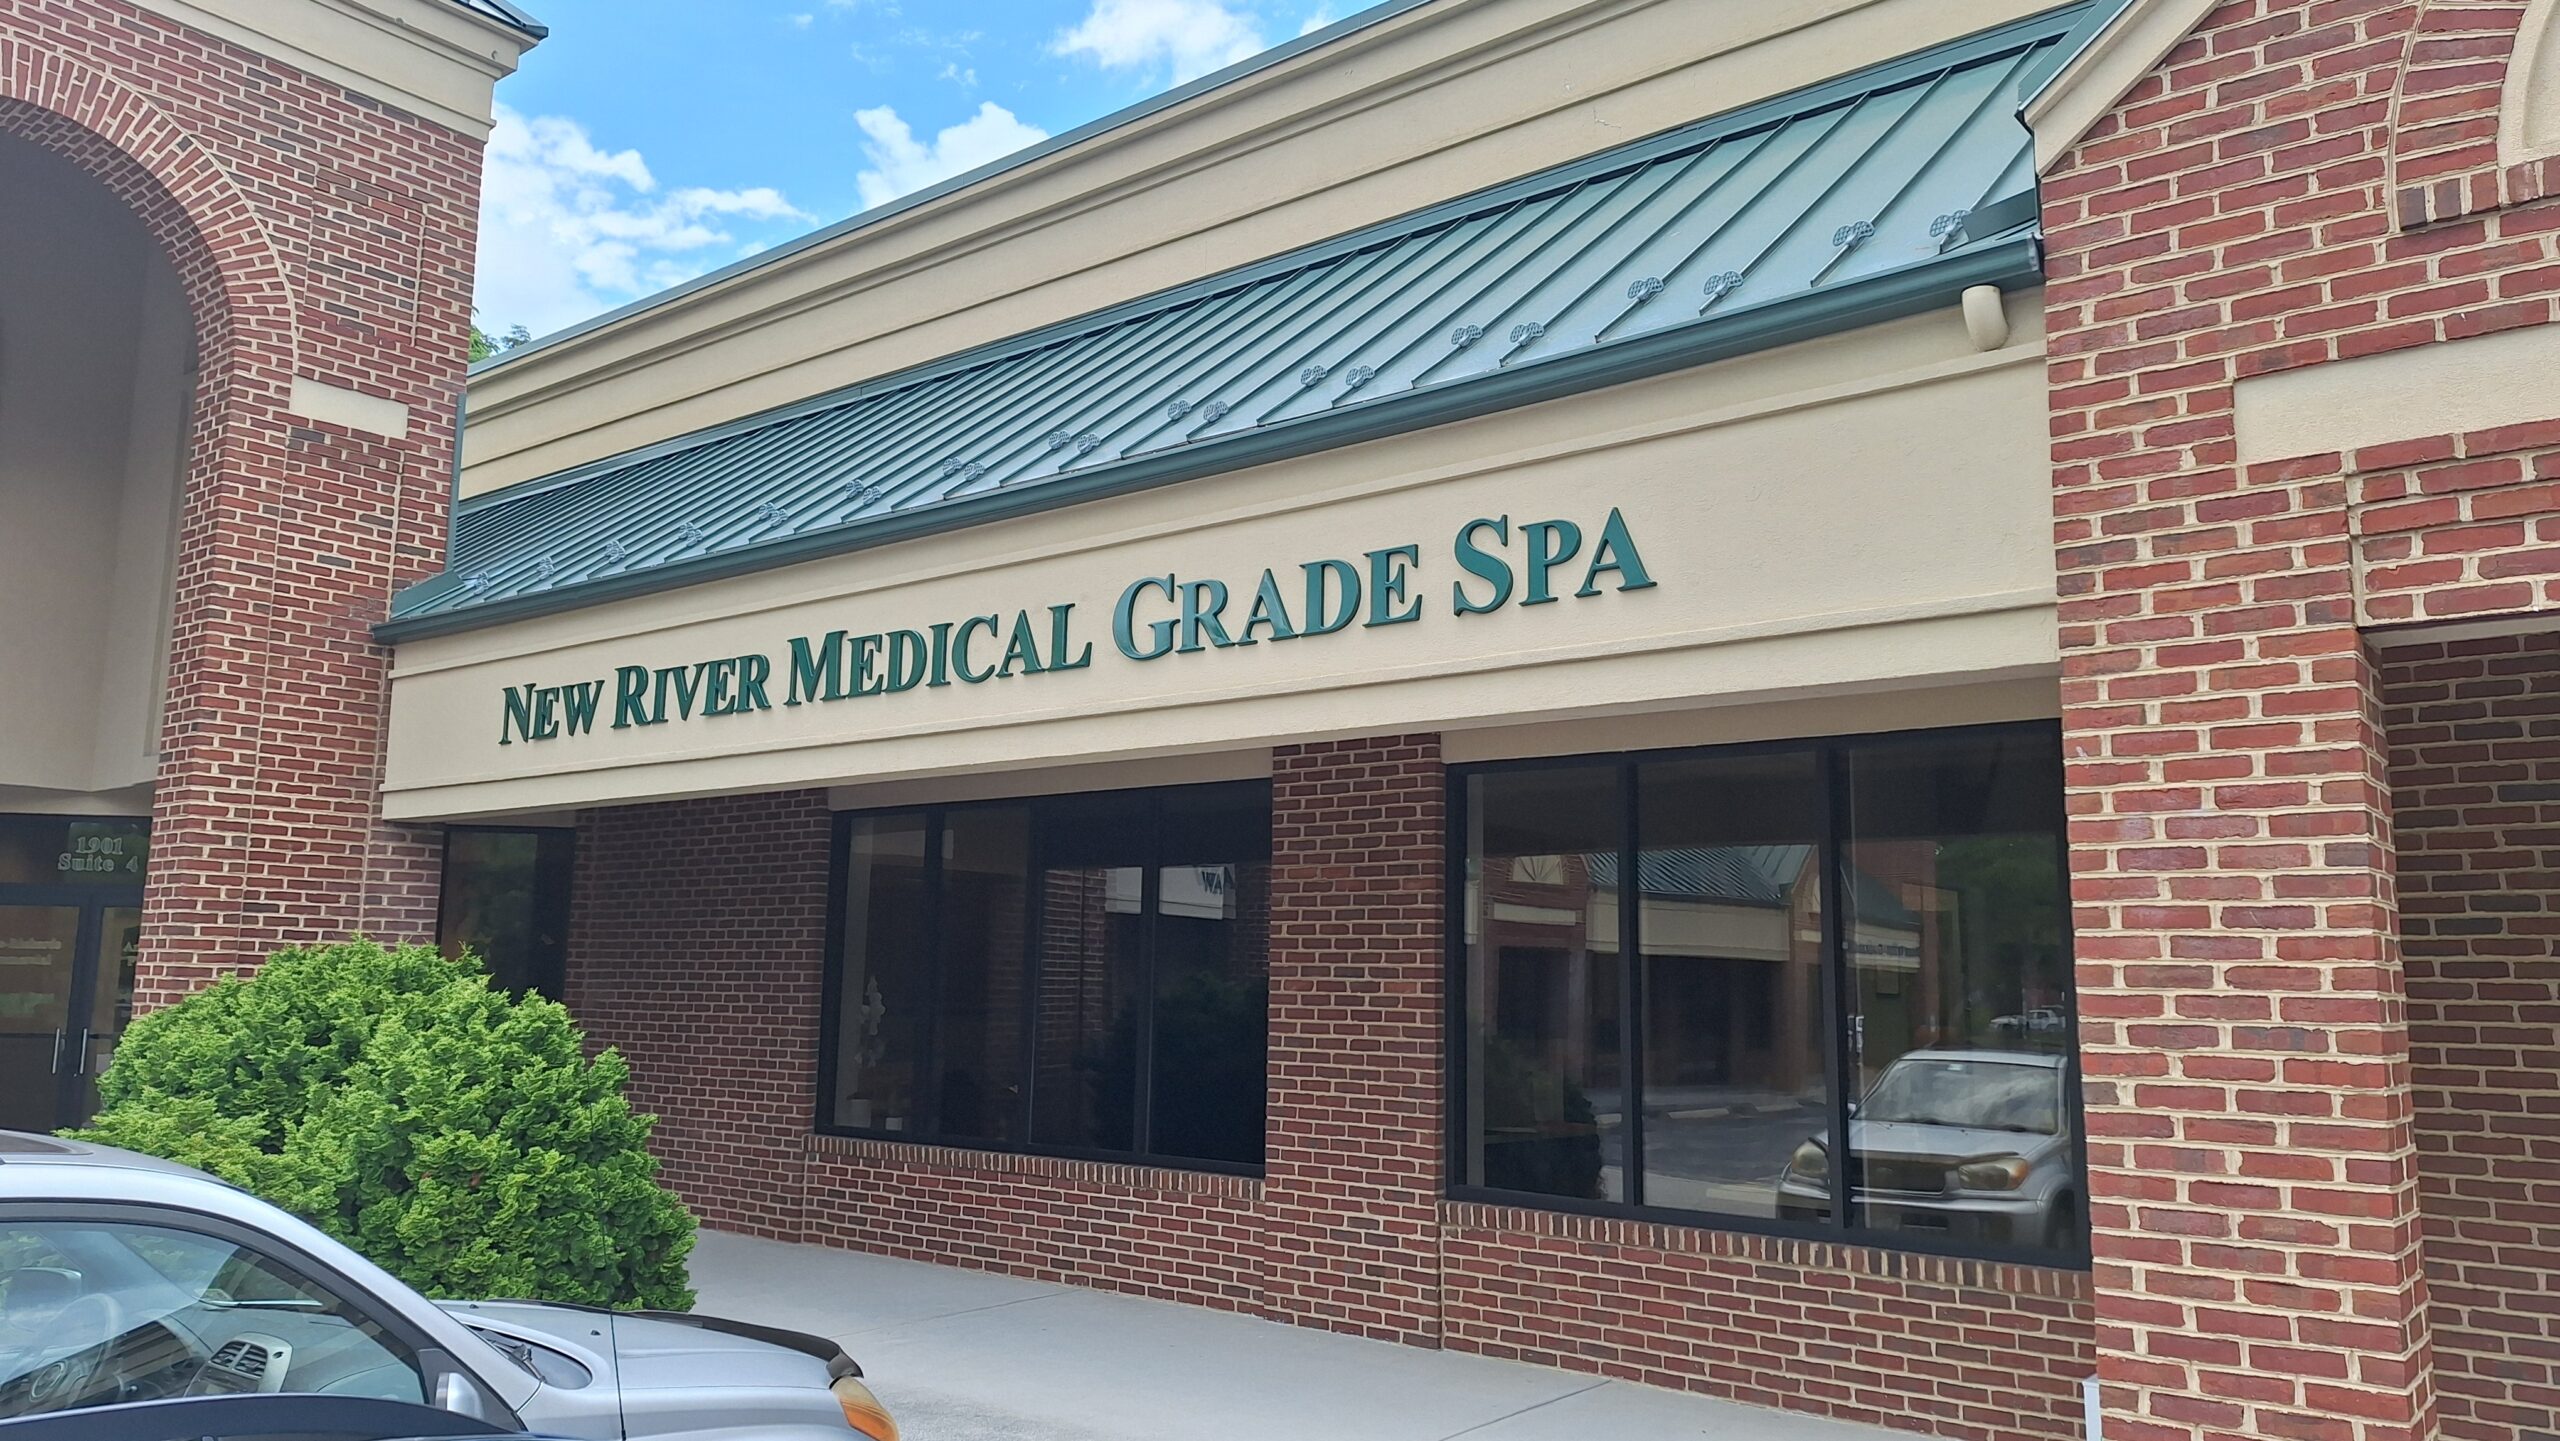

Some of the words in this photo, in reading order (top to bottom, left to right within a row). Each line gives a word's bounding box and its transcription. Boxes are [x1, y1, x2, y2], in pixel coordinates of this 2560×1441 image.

[499, 680, 604, 745] NEW
[610, 652, 771, 729] RIVER
[784, 602, 1092, 706] MEDICAL
[1112, 543, 1423, 661] GRADE
[1452, 506, 1658, 617] SPA
[75, 836, 123, 855] 1901
[57, 853, 114, 872] Suite
[125, 855, 138, 873] 4
